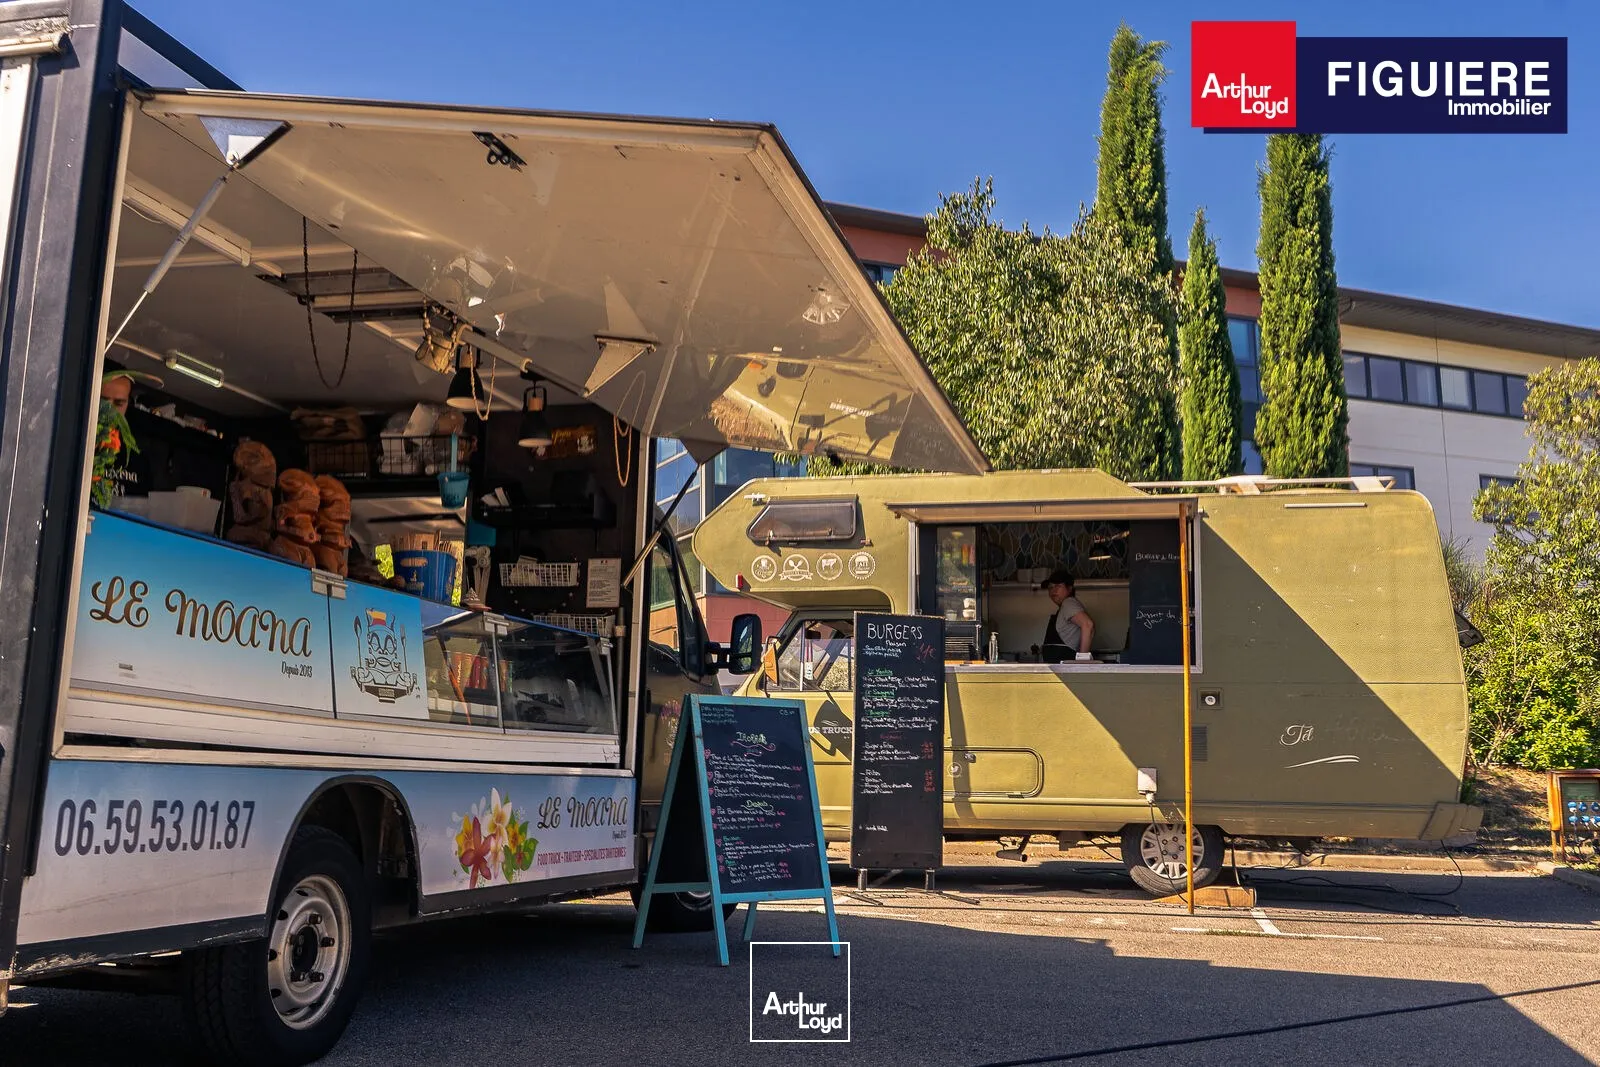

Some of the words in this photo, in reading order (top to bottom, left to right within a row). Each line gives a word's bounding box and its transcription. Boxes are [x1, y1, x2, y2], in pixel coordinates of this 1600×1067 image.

[88, 574, 151, 629] LE
[867, 623, 923, 640] BURGERS
[281, 661, 299, 678] Depuis
[299, 664, 313, 678] 2013
[54, 798, 256, 857] 06.59.53.01.87
[536, 796, 562, 829] LE
